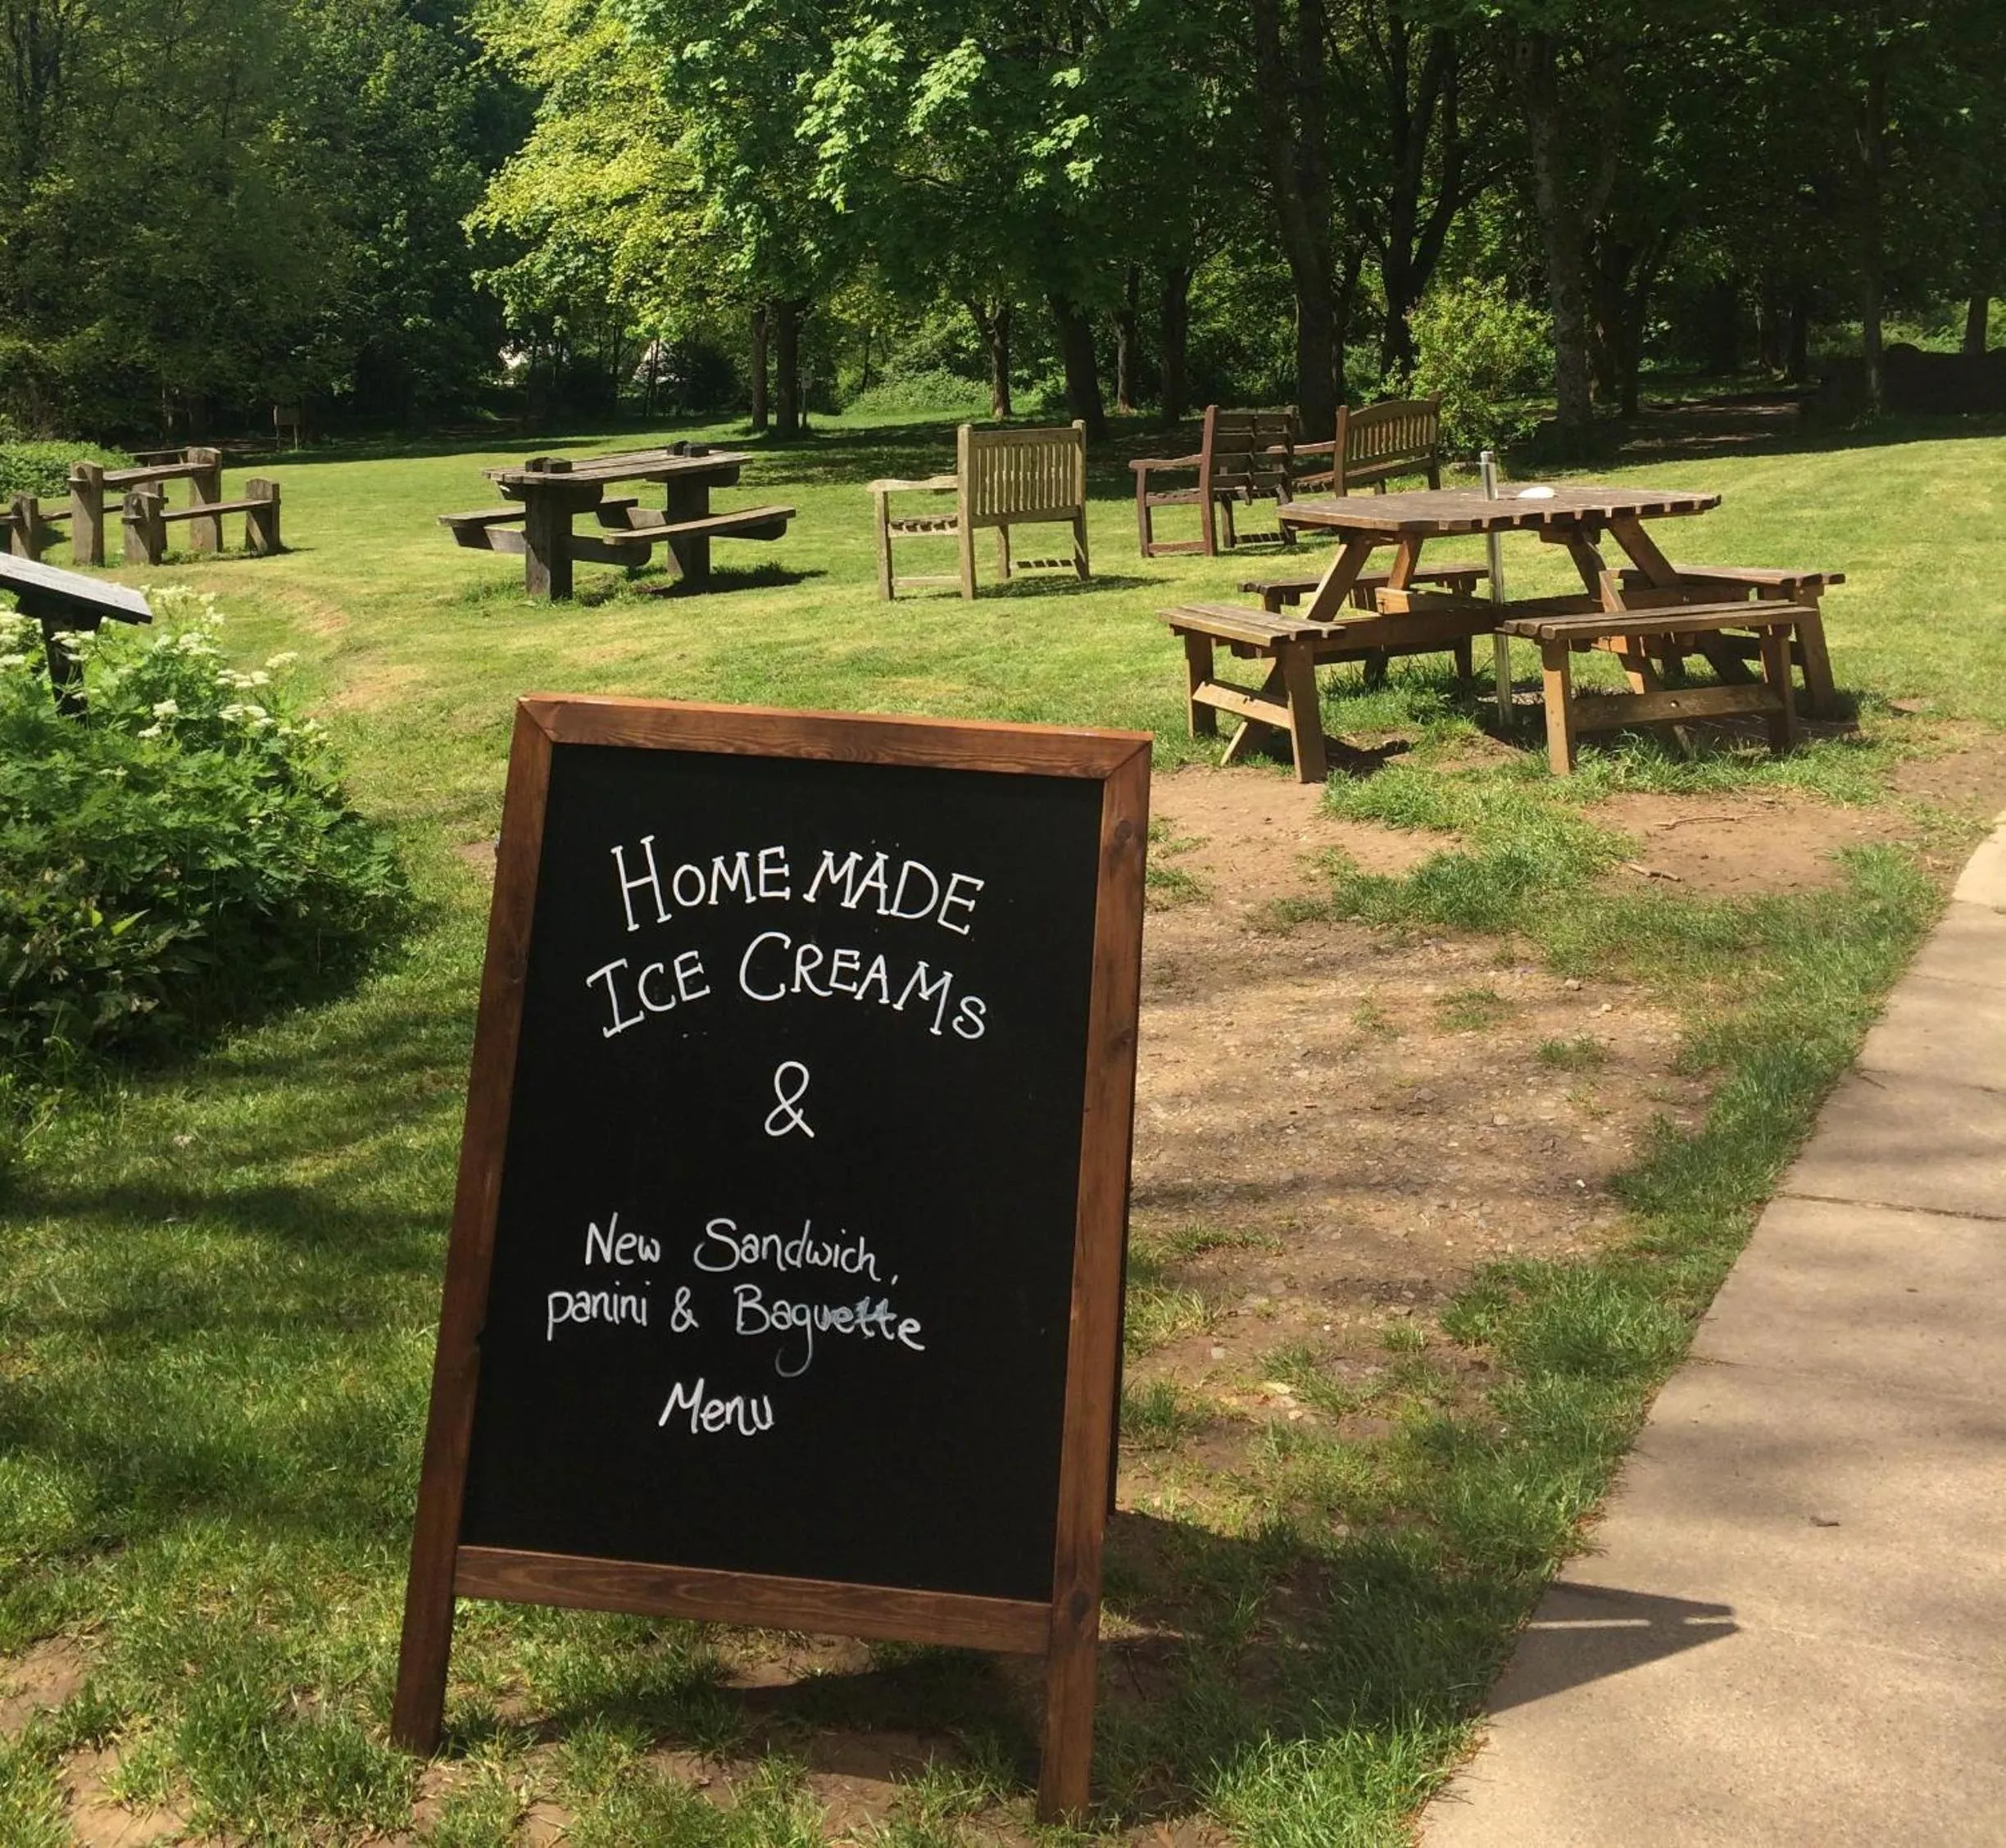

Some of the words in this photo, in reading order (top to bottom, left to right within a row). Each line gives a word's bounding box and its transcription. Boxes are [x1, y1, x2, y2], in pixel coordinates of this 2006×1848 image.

[802, 849, 985, 935] MADE
[586, 949, 711, 1038] ICE
[764, 1060, 815, 1138] &
[584, 1212, 661, 1265] New
[547, 1281, 651, 1342] panini
[670, 1286, 699, 1333] &
[733, 1283, 926, 1378] Baguette
[658, 1377, 775, 1436] Menu
